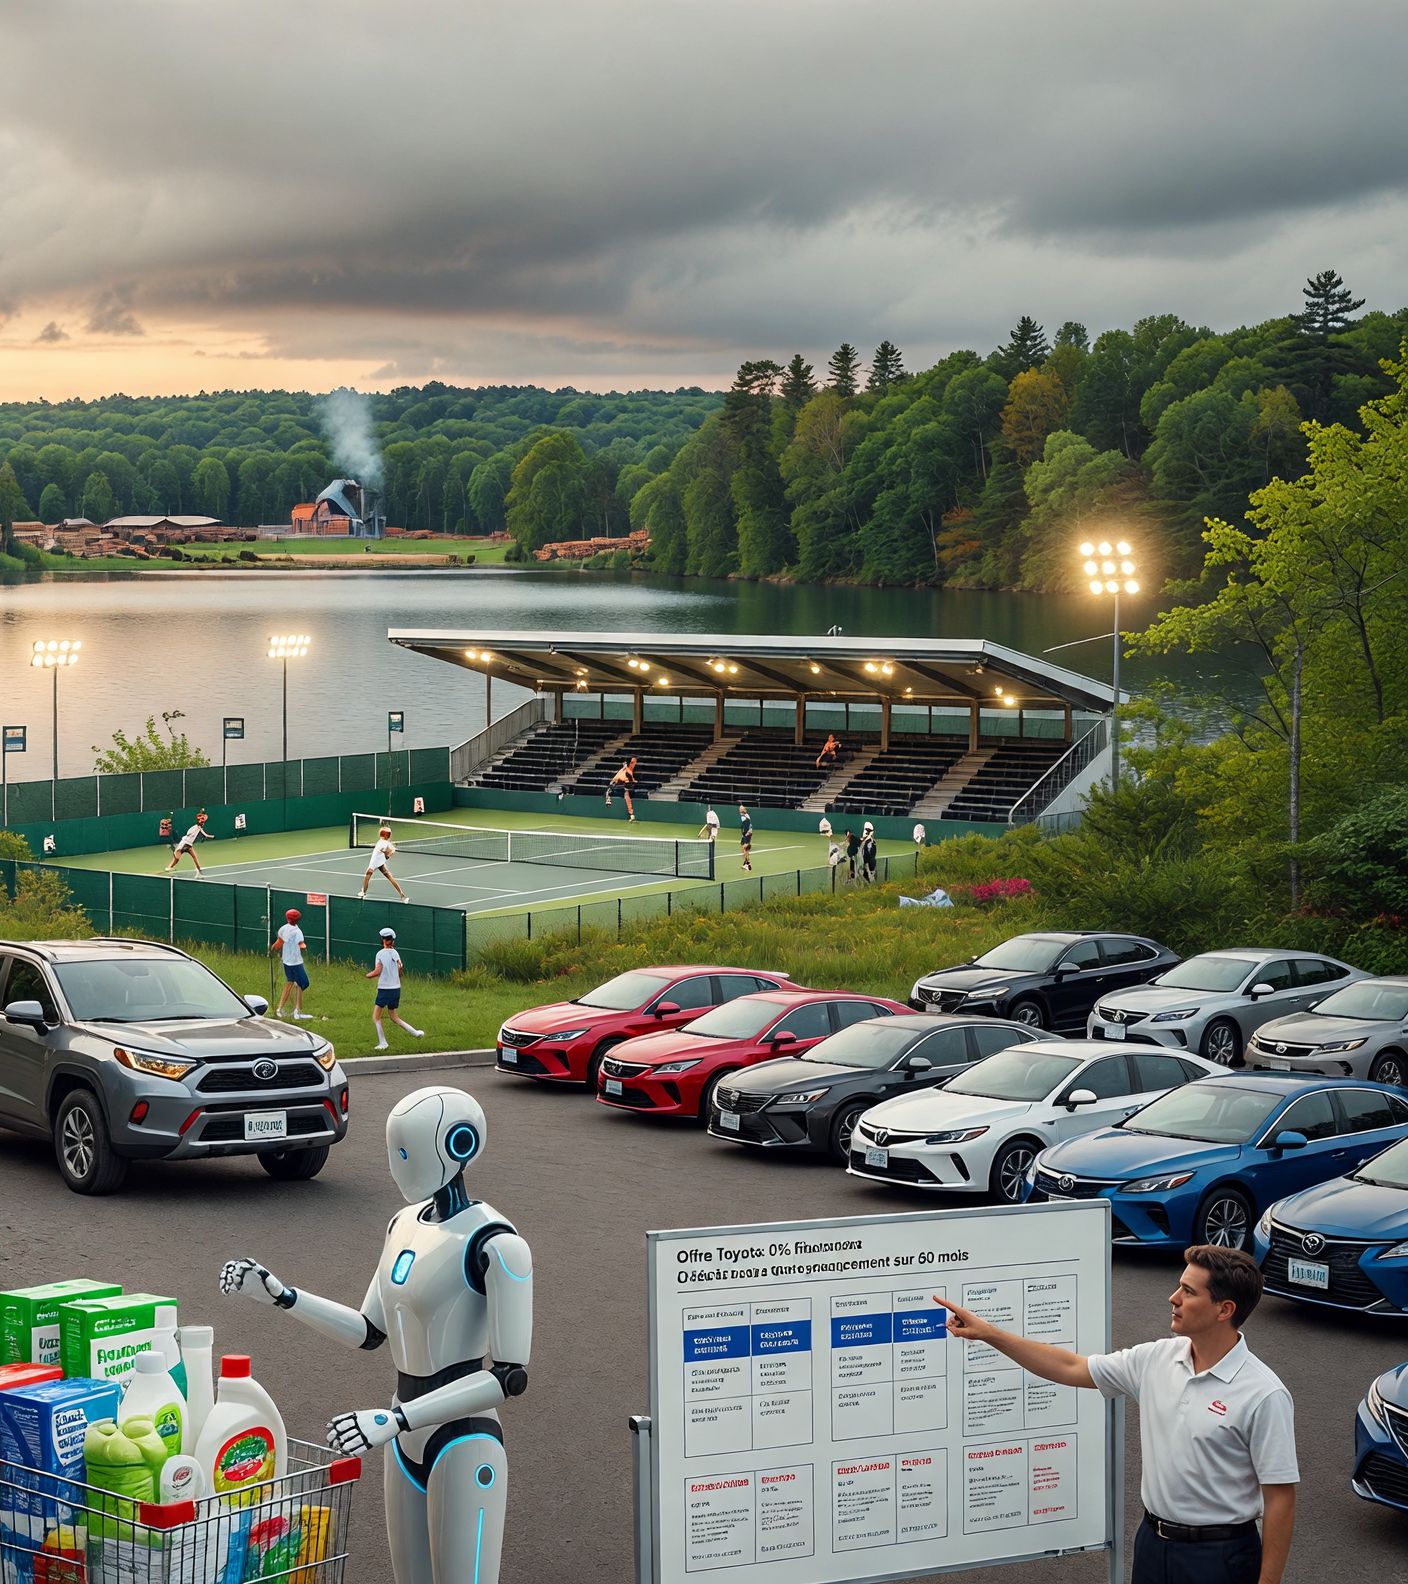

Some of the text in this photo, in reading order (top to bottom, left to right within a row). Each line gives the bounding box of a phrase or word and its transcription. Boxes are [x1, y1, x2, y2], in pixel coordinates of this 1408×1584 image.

[677, 1248, 713, 1264] Offre
[769, 1242, 791, 1257] 0%
[893, 1255, 915, 1267] sur
[918, 1251, 935, 1265] 60
[937, 1248, 969, 1264] mois
